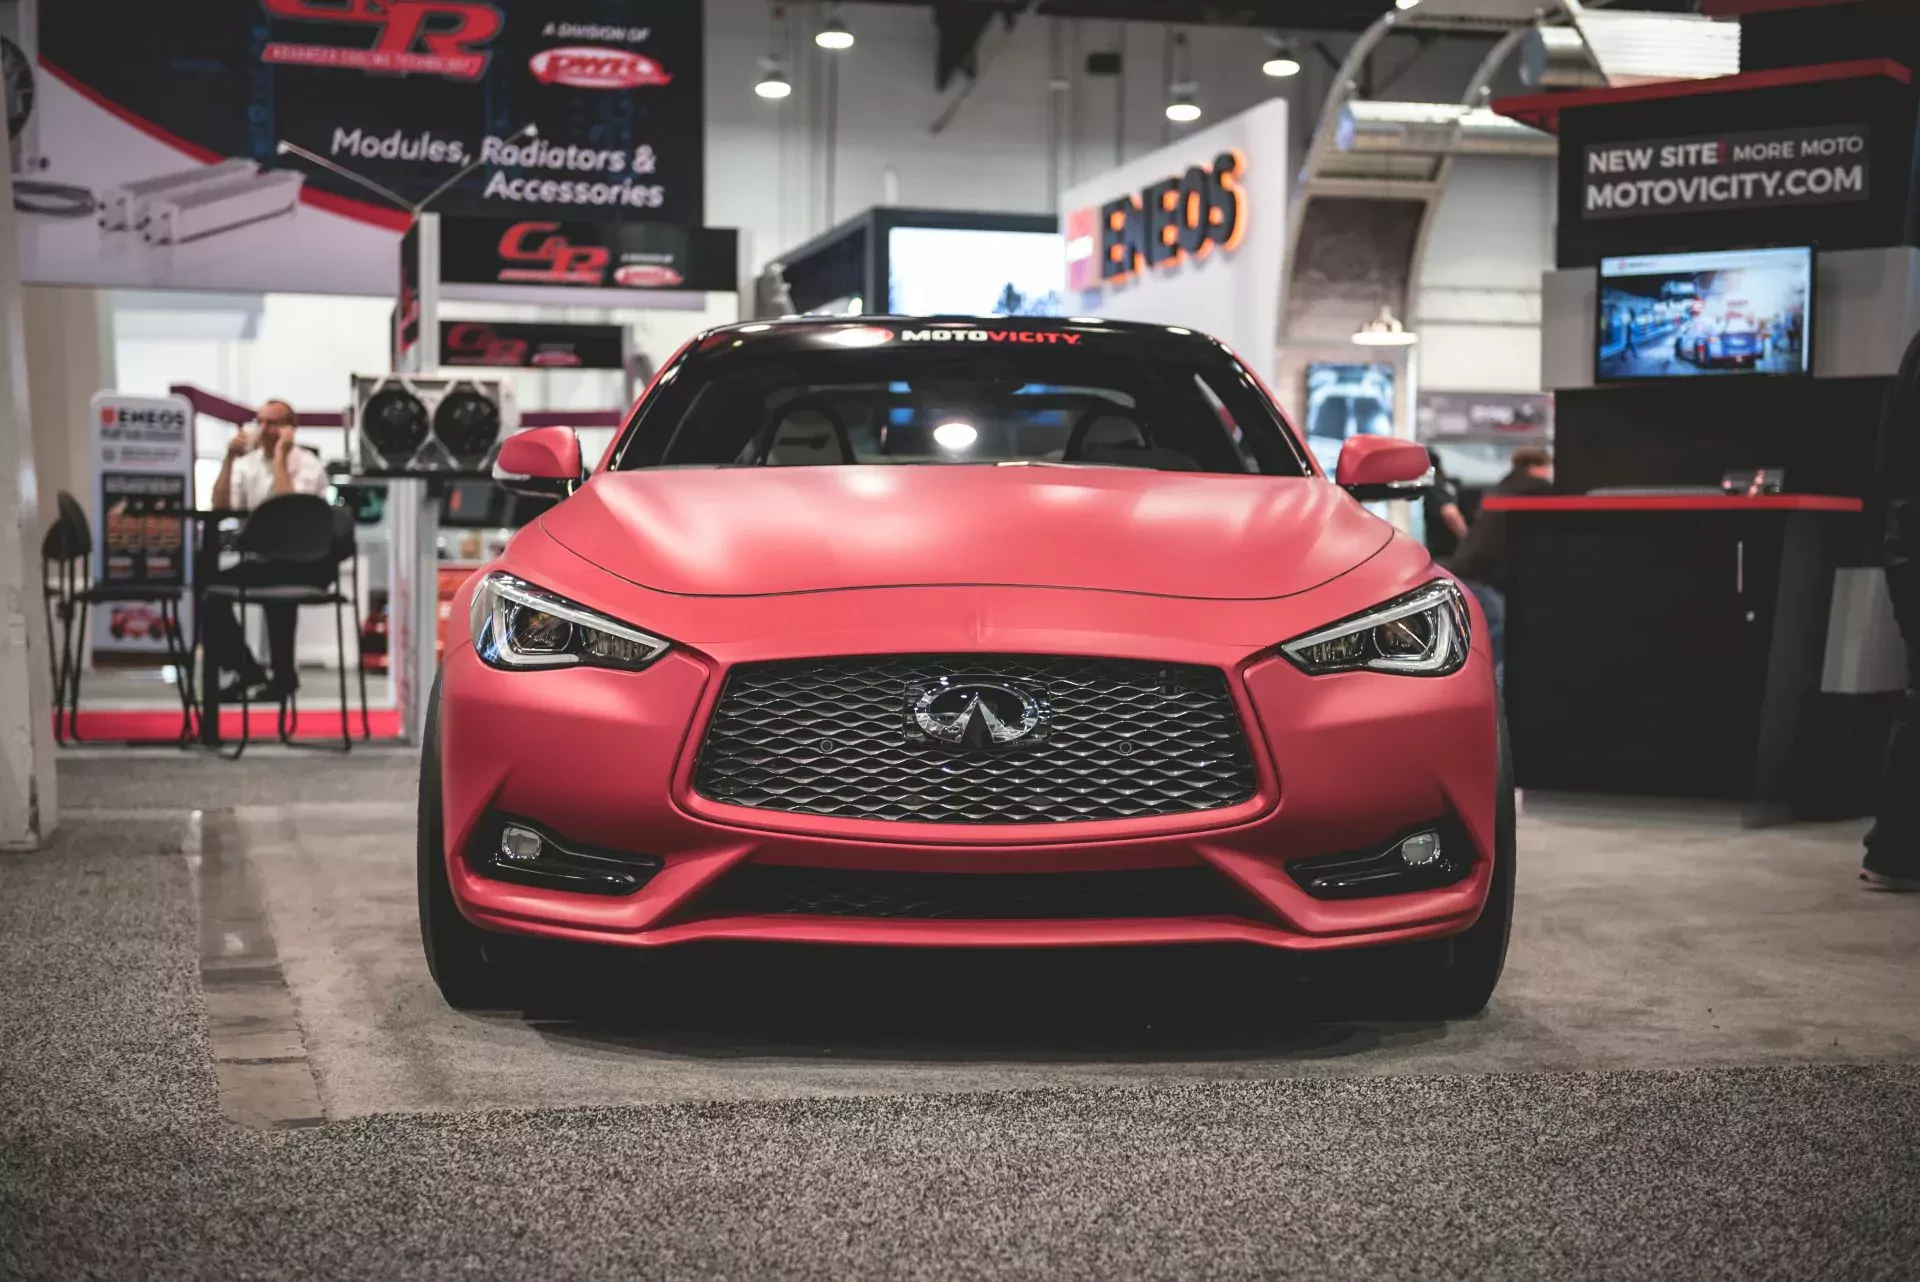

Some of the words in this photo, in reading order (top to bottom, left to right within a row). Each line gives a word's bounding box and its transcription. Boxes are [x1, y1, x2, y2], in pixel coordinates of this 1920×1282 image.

[541, 21, 555, 36] A
[331, 127, 471, 166] Modules,
[481, 136, 626, 172] Radiators
[632, 144, 657, 173] &
[1588, 147, 1653, 173] NEW
[1732, 141, 1795, 162] MORE
[1800, 135, 1864, 158] MOTO
[484, 170, 664, 207] Accessories
[1586, 164, 1863, 210] MOTOVICITY.COM
[1101, 149, 1248, 284] ENEOS
[901, 329, 1082, 345] MOTOVICITY
[118, 408, 185, 426] ENEOS
